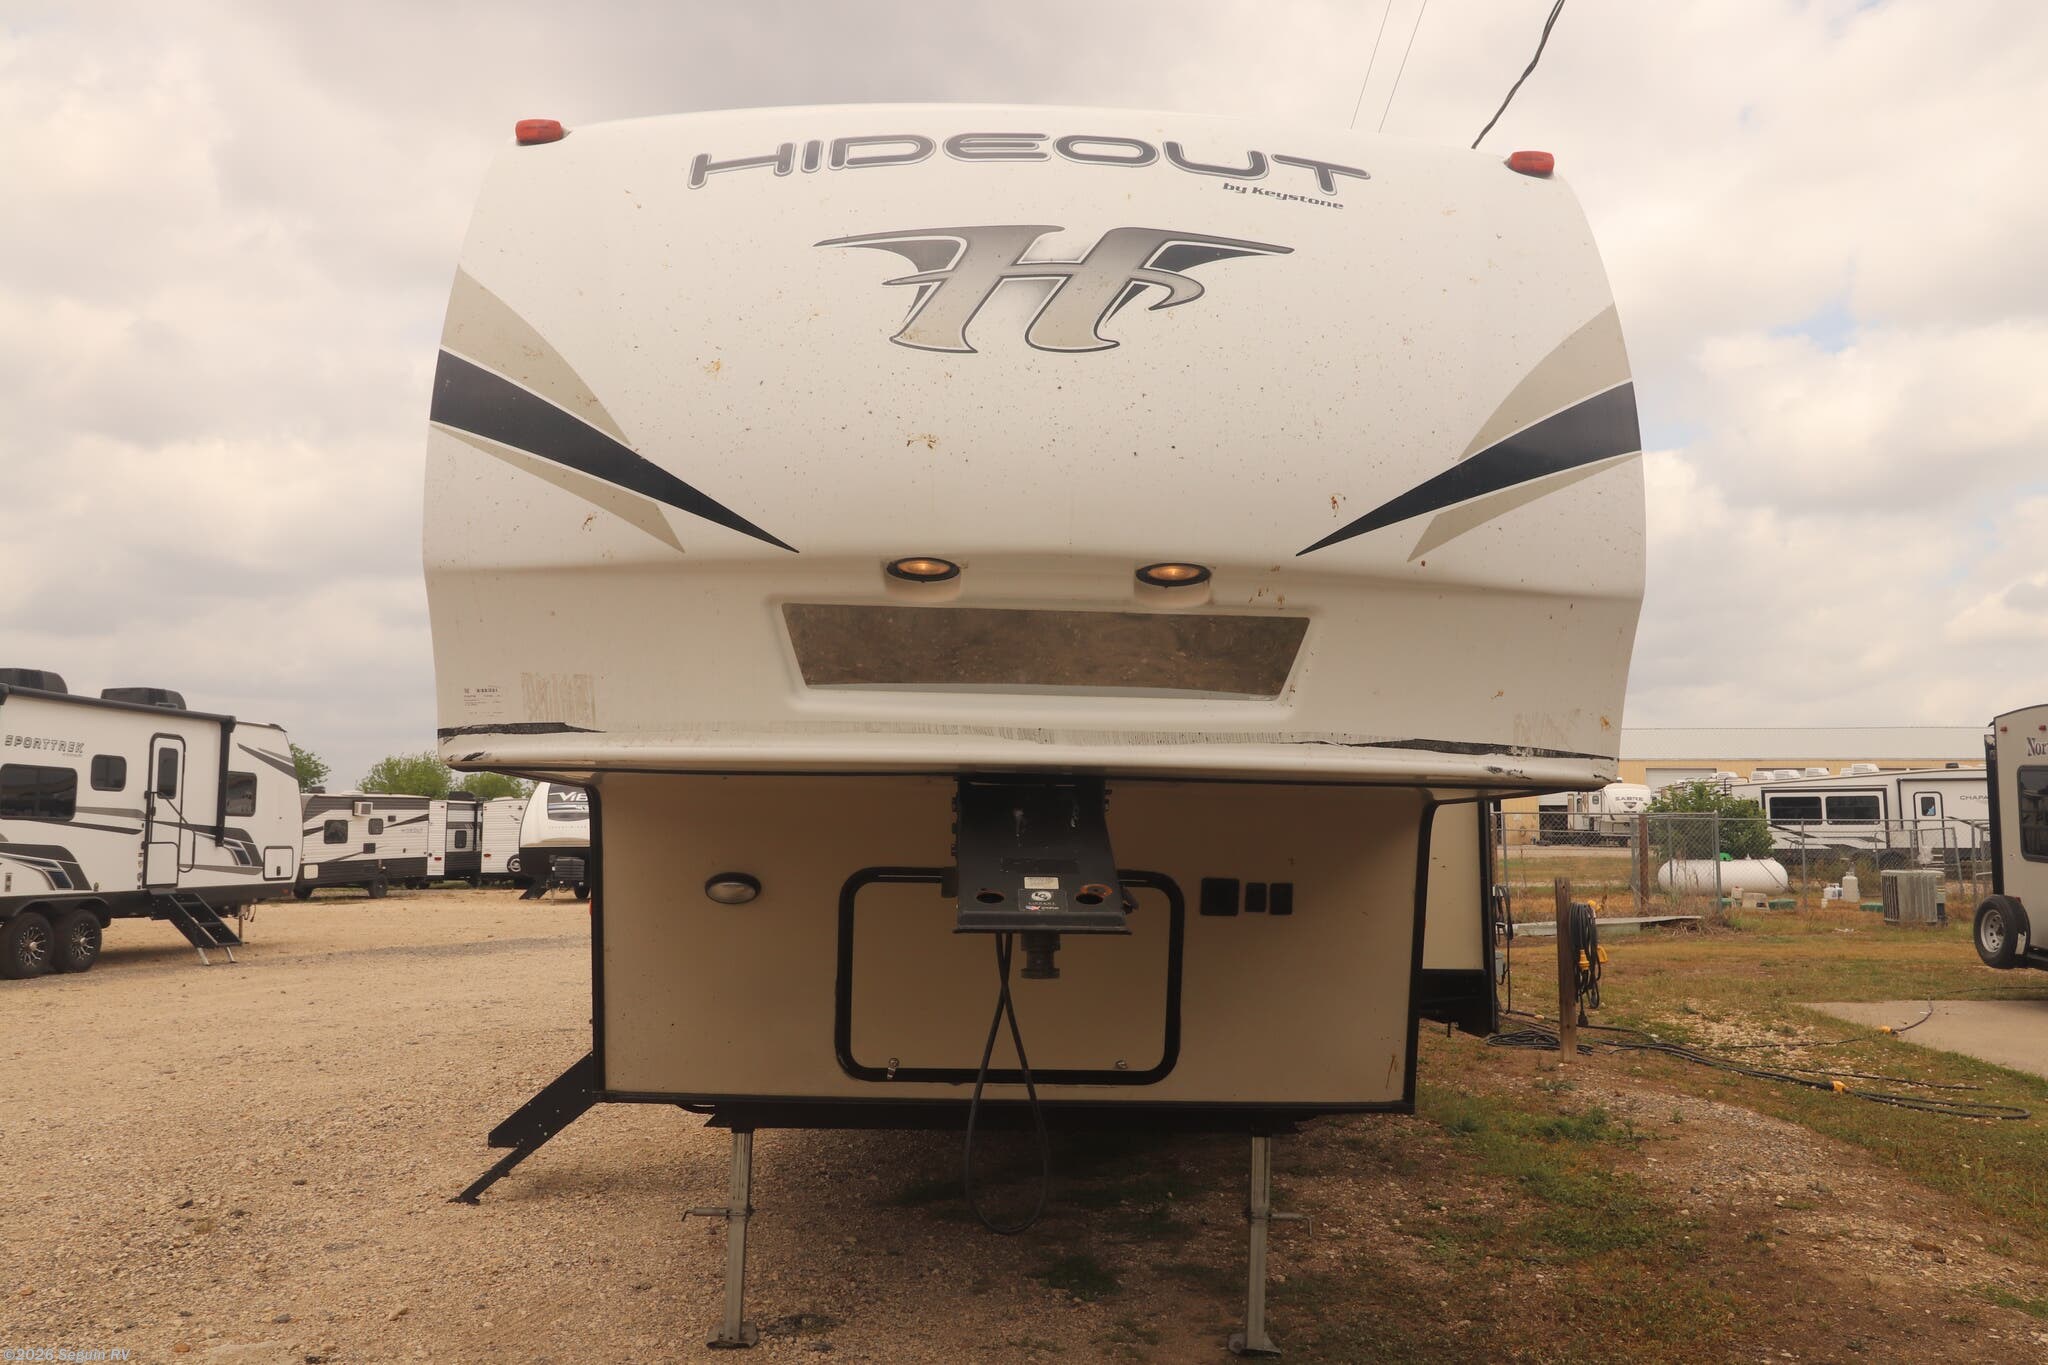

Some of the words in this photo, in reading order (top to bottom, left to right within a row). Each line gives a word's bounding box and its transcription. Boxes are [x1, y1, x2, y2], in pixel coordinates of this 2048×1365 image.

[687, 132, 1371, 196] HIDEOUT
[1222, 183, 1248, 194] by
[1252, 187, 1344, 209] Keystone
[5, 734, 85, 753] SPORTTREK
[2026, 736, 2048, 757] Nor
